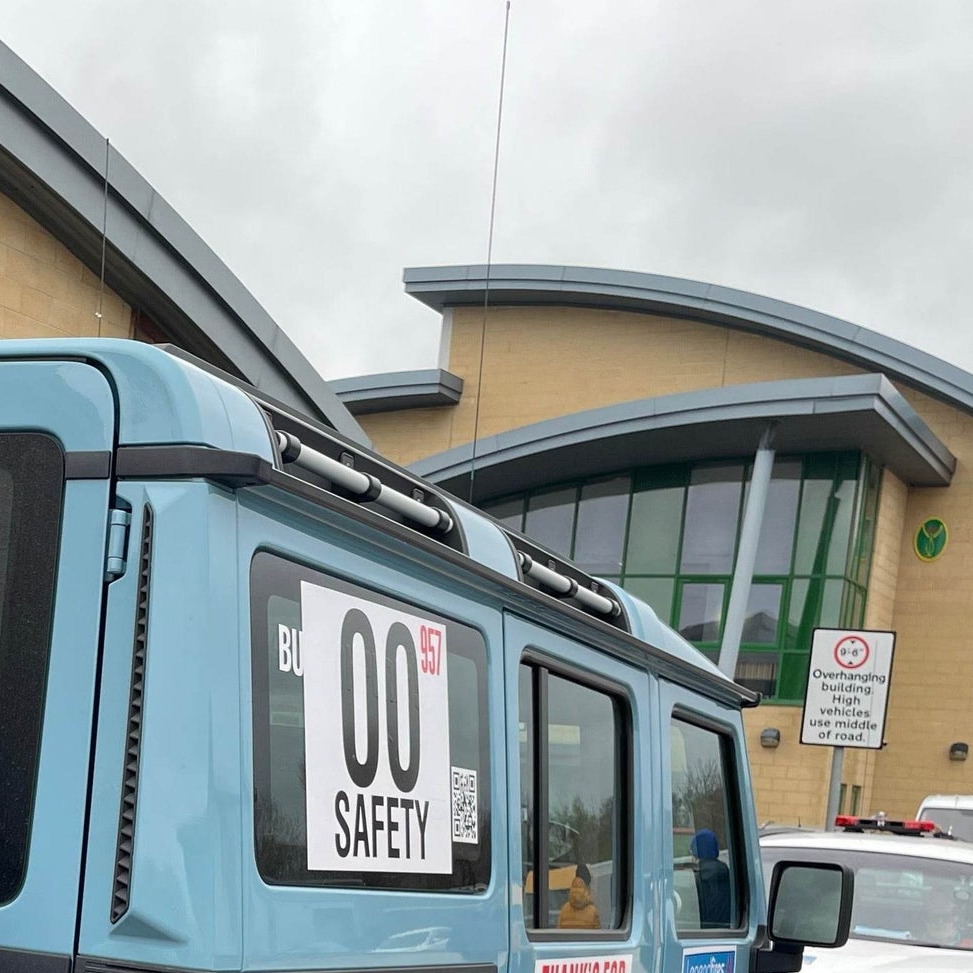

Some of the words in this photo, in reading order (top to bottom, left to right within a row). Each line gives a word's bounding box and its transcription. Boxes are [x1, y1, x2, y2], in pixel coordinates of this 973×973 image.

[420, 625, 442, 676] 957
[813, 668, 886, 684] Overhanging
[832, 694, 861, 706] High
[820, 706, 870, 718] vehicles
[809, 718, 831, 728] use
[835, 719, 877, 731] middle
[818, 730, 832, 740] of
[835, 731, 866, 742] road.
[335, 790, 429, 860] SAFETY
